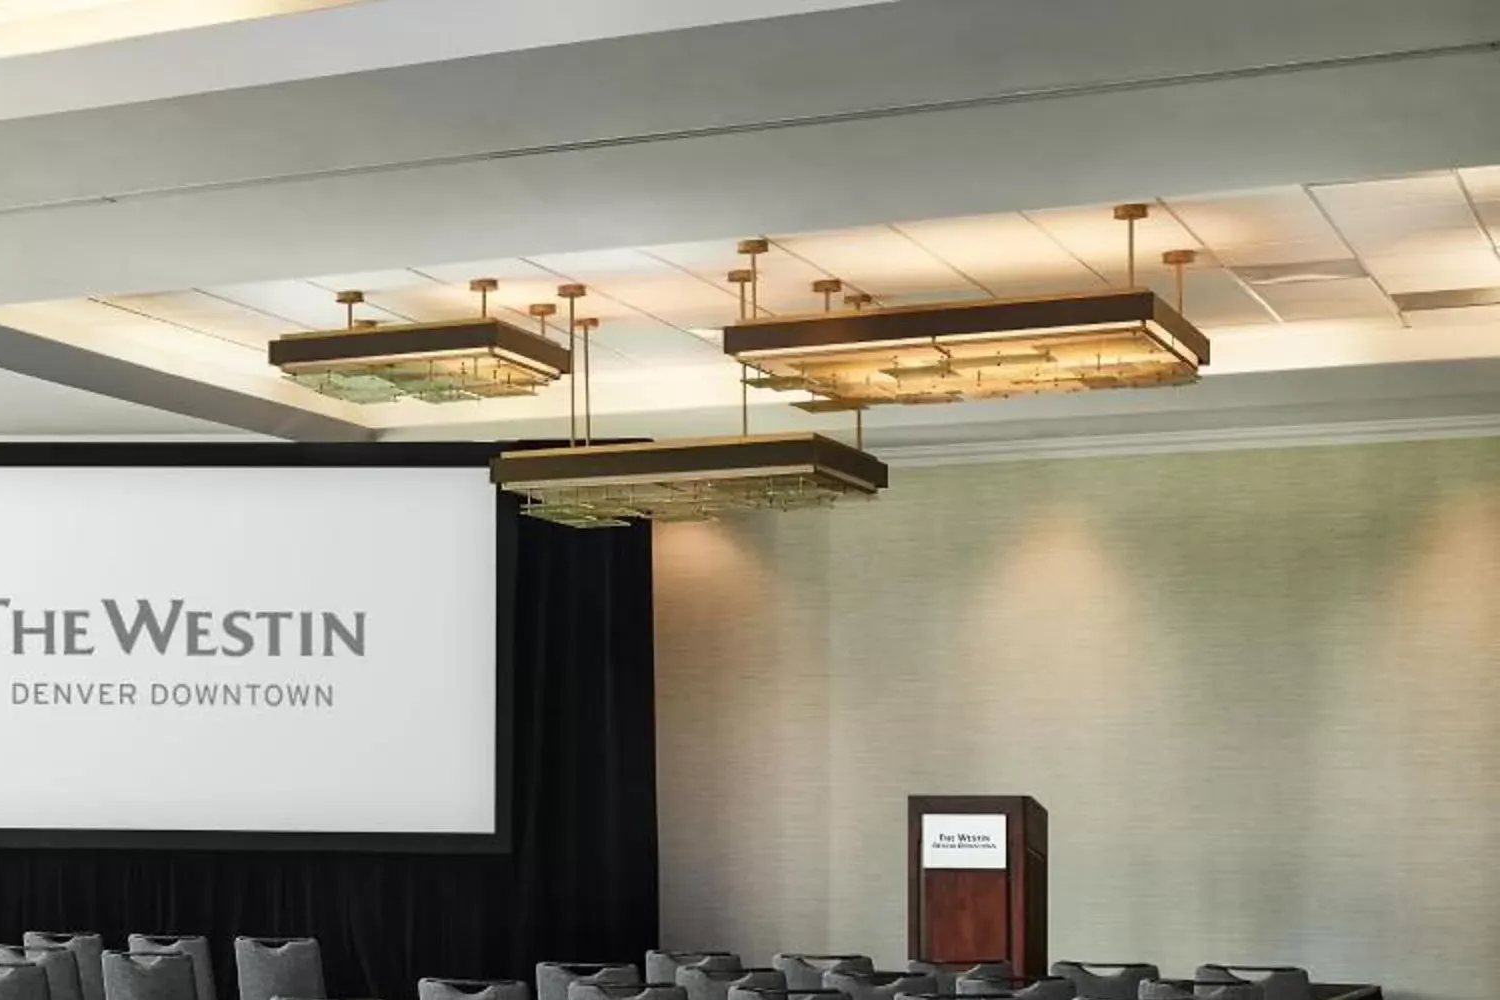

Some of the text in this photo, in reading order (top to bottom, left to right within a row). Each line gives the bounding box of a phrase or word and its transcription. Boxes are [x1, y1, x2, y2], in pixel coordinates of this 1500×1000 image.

[101, 598, 366, 657] WESTIN
[11, 682, 334, 707] DENVER DOWNTOWN
